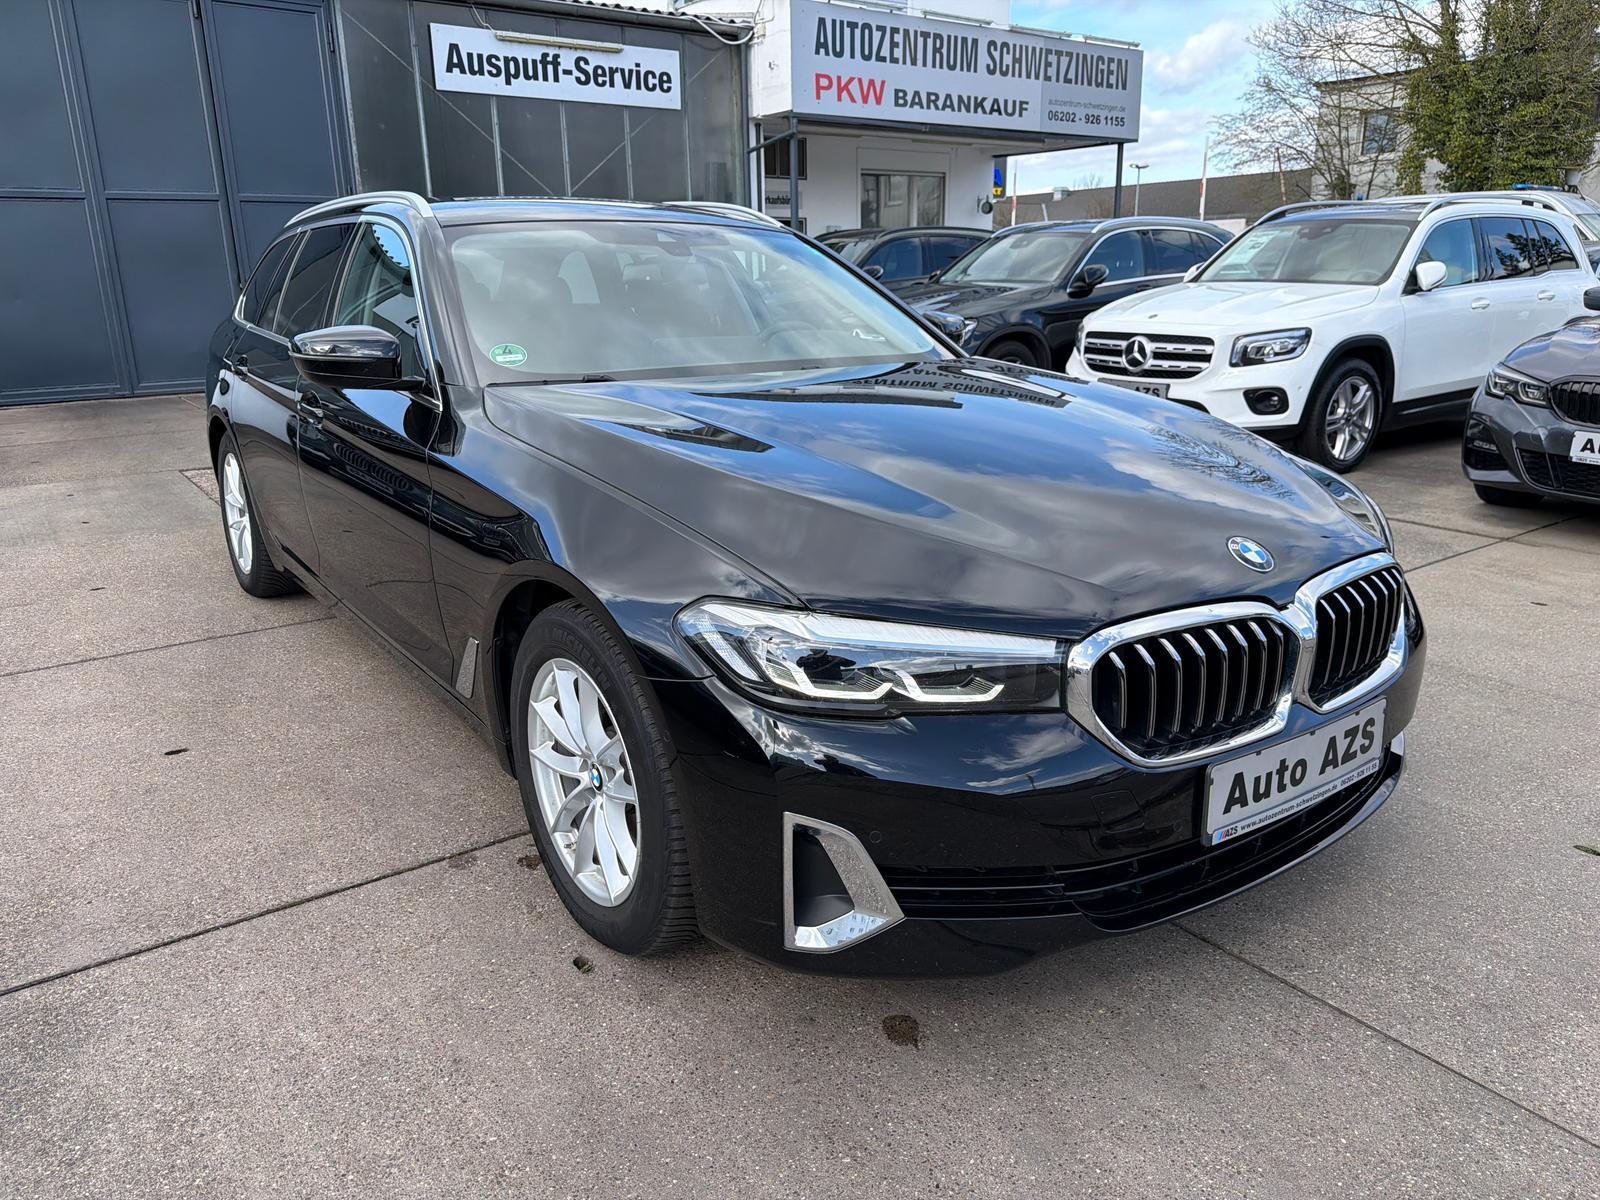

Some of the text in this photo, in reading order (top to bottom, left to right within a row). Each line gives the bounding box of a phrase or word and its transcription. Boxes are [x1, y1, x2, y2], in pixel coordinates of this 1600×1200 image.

[446, 42, 672, 93] Auspuff-Service
[814, 16, 1129, 91] AUTOZENTRUM SCHWETZINGEN
[814, 73, 1029, 118] PKW BARANKAUF
[1047, 110, 1077, 123] 06202
[1084, 113, 1101, 125] 926
[1104, 115, 1126, 127] 1155
[1048, 99, 1126, 113] autozentrum-schwetzingen.de
[1580, 437, 1600, 454] A
[1222, 717, 1376, 815] Auto AZS
[1240, 783, 1338, 831] www.autozentrum-schwetzingen.de
